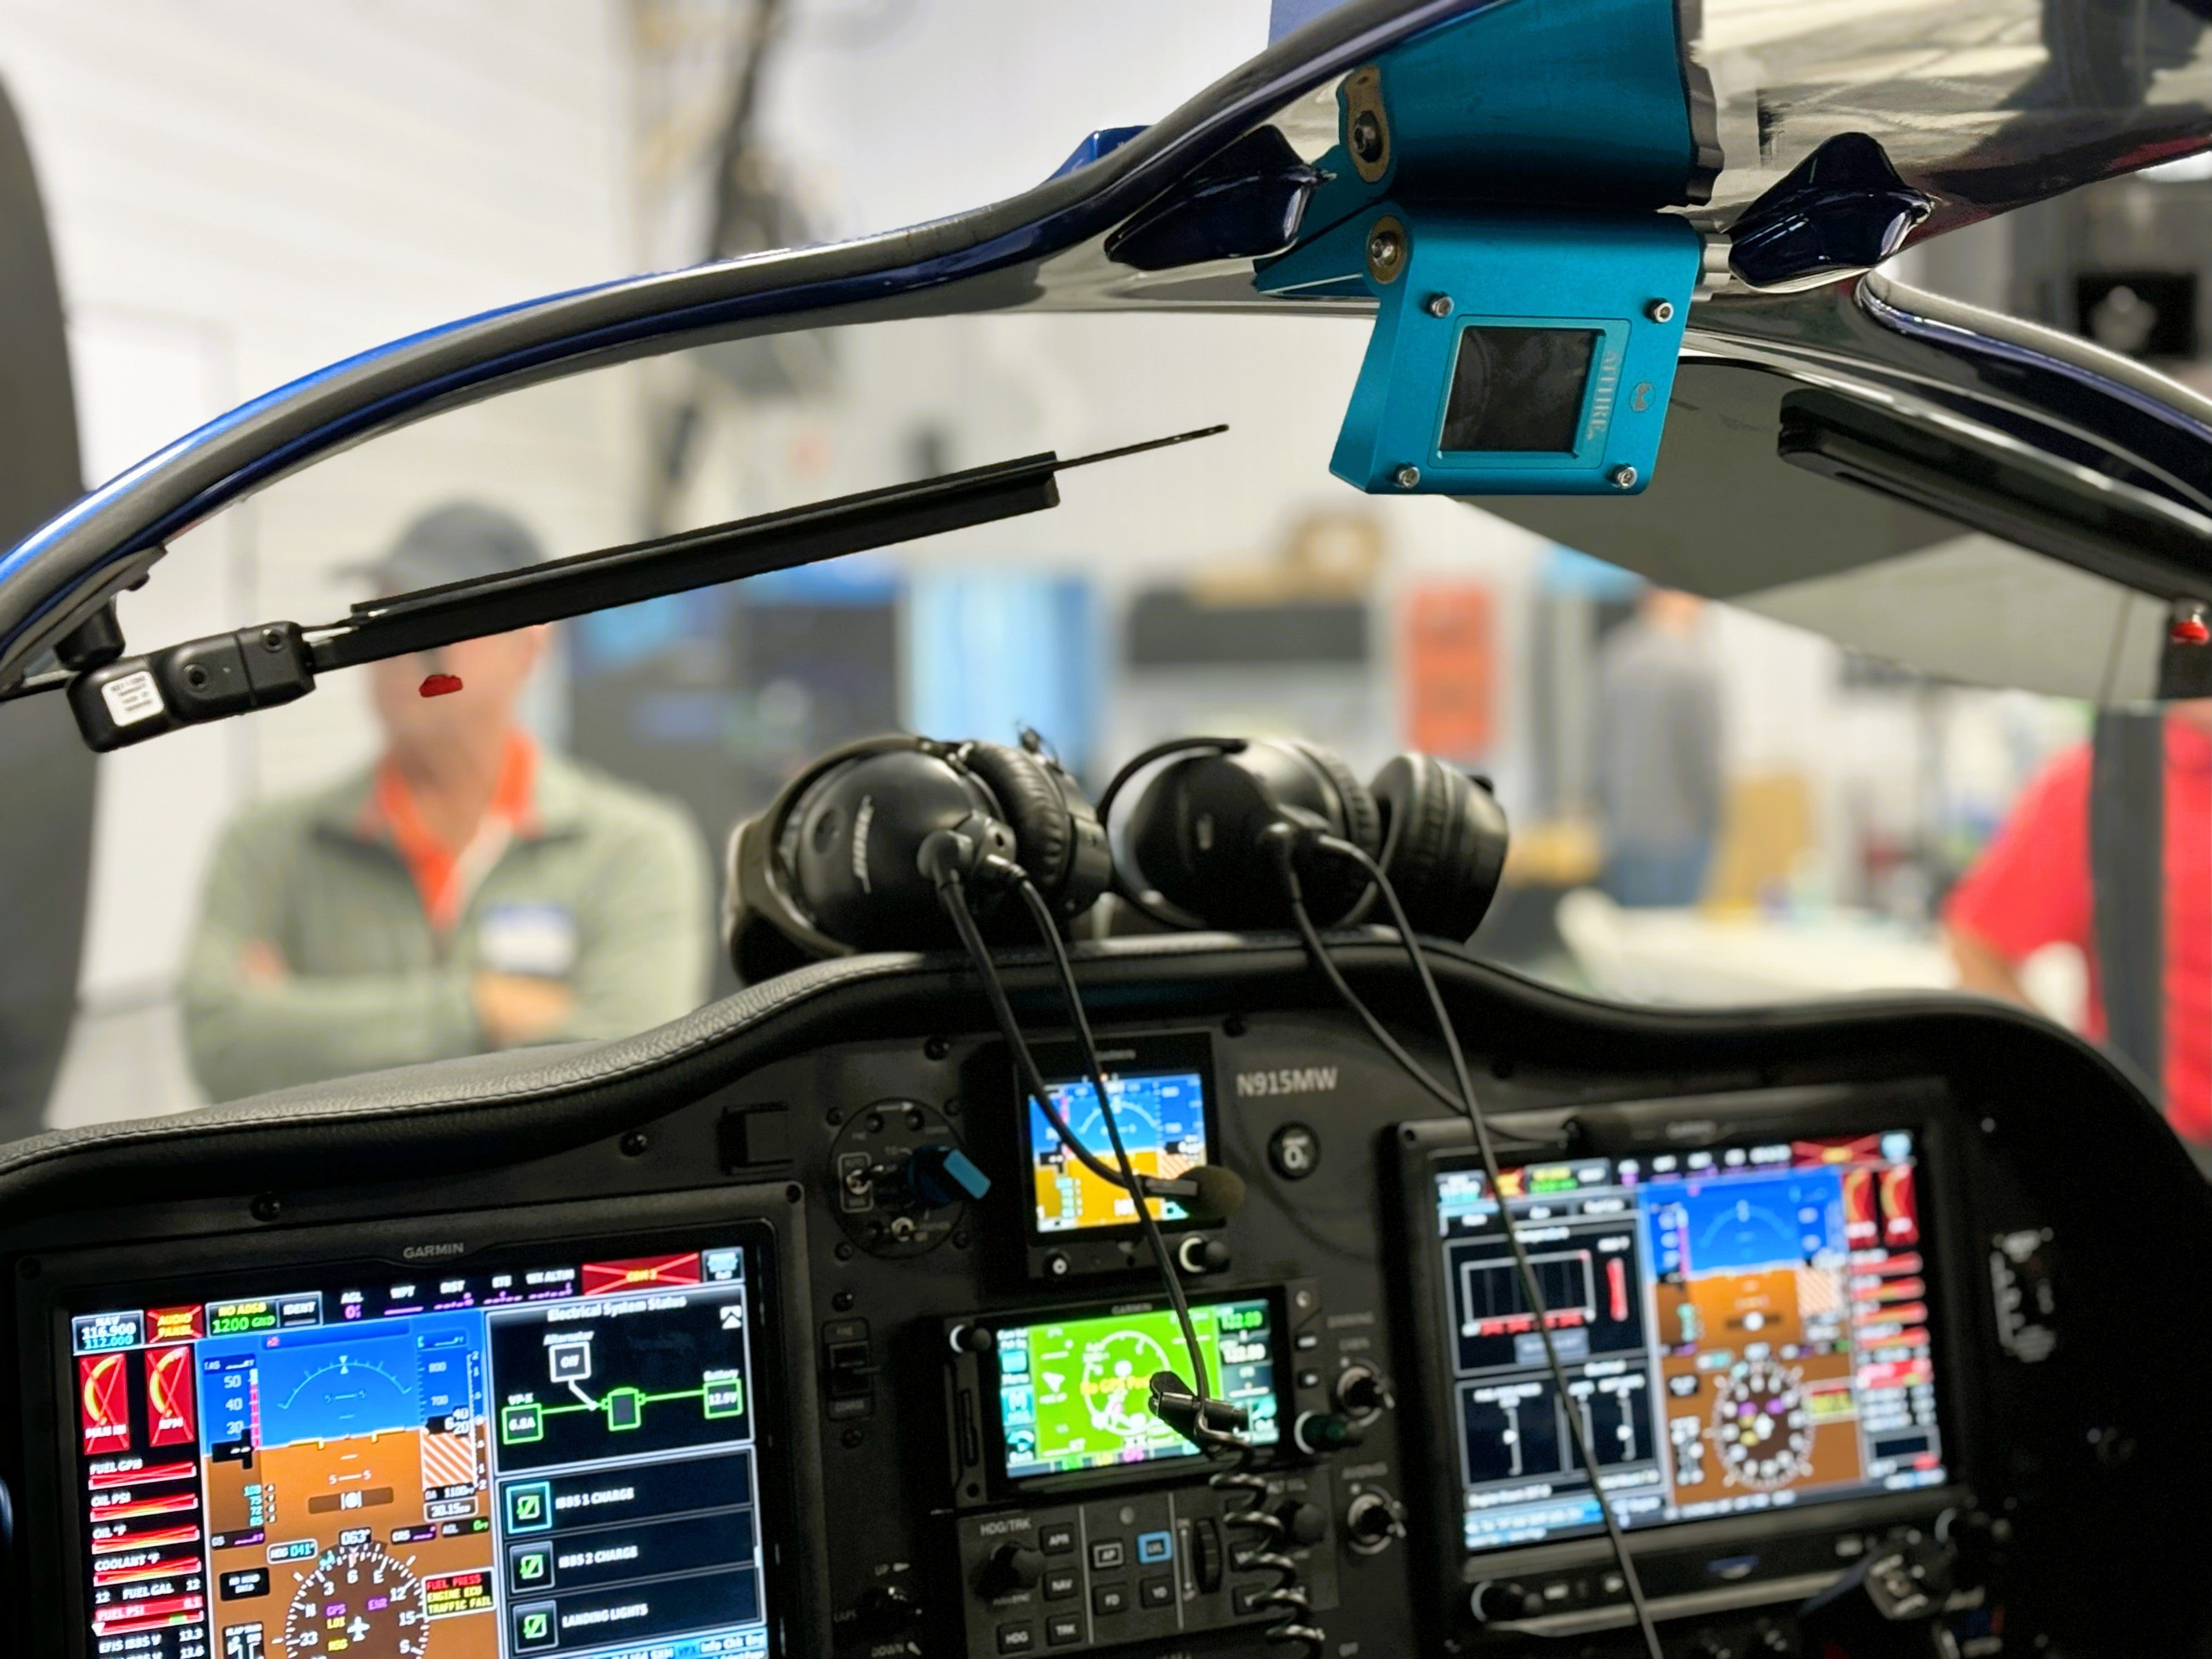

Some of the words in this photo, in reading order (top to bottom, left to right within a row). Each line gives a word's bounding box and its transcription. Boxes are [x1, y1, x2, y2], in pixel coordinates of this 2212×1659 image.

[1237, 1067, 1338, 1096] N915MW
[403, 1242, 464, 1259] GARMIN
[283, 1301, 315, 1315] IDENT
[548, 1304, 601, 1322] Electrical
[603, 1300, 646, 1317] System
[648, 1296, 687, 1311] Status
[212, 1317, 249, 1334] 1200
[224, 1375, 241, 1388] 50
[225, 1398, 242, 1410] 40
[227, 1420, 244, 1435] 30
[980, 1518, 1031, 1536] HDG/TRK
[1048, 1533, 1070, 1545] APR
[94, 1554, 146, 1571] COOLANT
[347, 1569, 358, 1584] 6
[427, 1578, 448, 1591] FUEL
[452, 1573, 482, 1587] PRESS
[1052, 1578, 1073, 1590] NAV
[122, 1586, 151, 1600] FUEL
[151, 1582, 175, 1596] GAL
[390, 1587, 407, 1602] 12
[427, 1589, 461, 1602] ENGINE
[428, 1599, 467, 1615] TRAFFIC
[469, 1595, 493, 1609] FAIL
[562, 1609, 610, 1628] LANDING
[610, 1603, 648, 1621] LIGHTS
[1055, 1623, 1076, 1636] TRK
[1005, 1632, 1029, 1644] HDG
